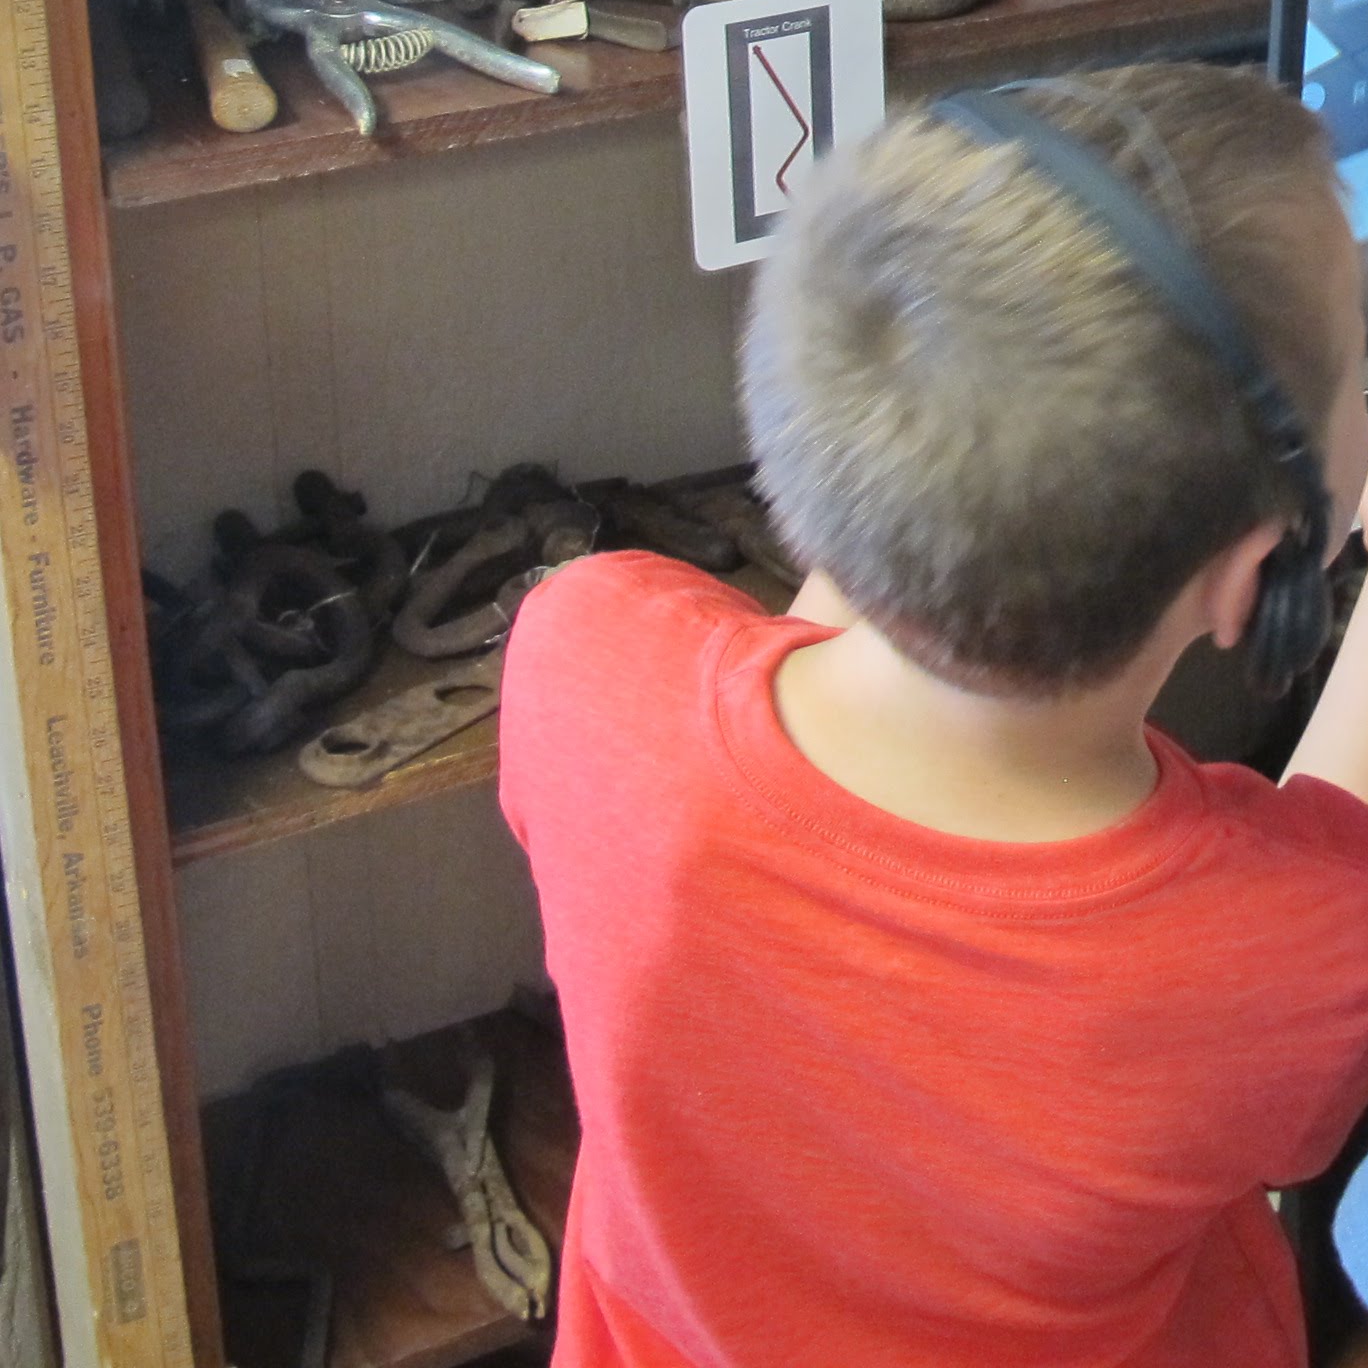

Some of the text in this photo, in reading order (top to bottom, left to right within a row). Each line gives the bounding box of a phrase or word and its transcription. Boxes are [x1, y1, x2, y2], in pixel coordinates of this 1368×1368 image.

[743, 18, 811, 38] Tractor Crank
[1, 286, 26, 345] GAS
[11, 404, 40, 527] Hardware
[28, 551, 57, 666] Furniture
[47, 714, 79, 841] Leachville,
[62, 852, 89, 961] Arkansas
[82, 1003, 104, 1076] Phone
